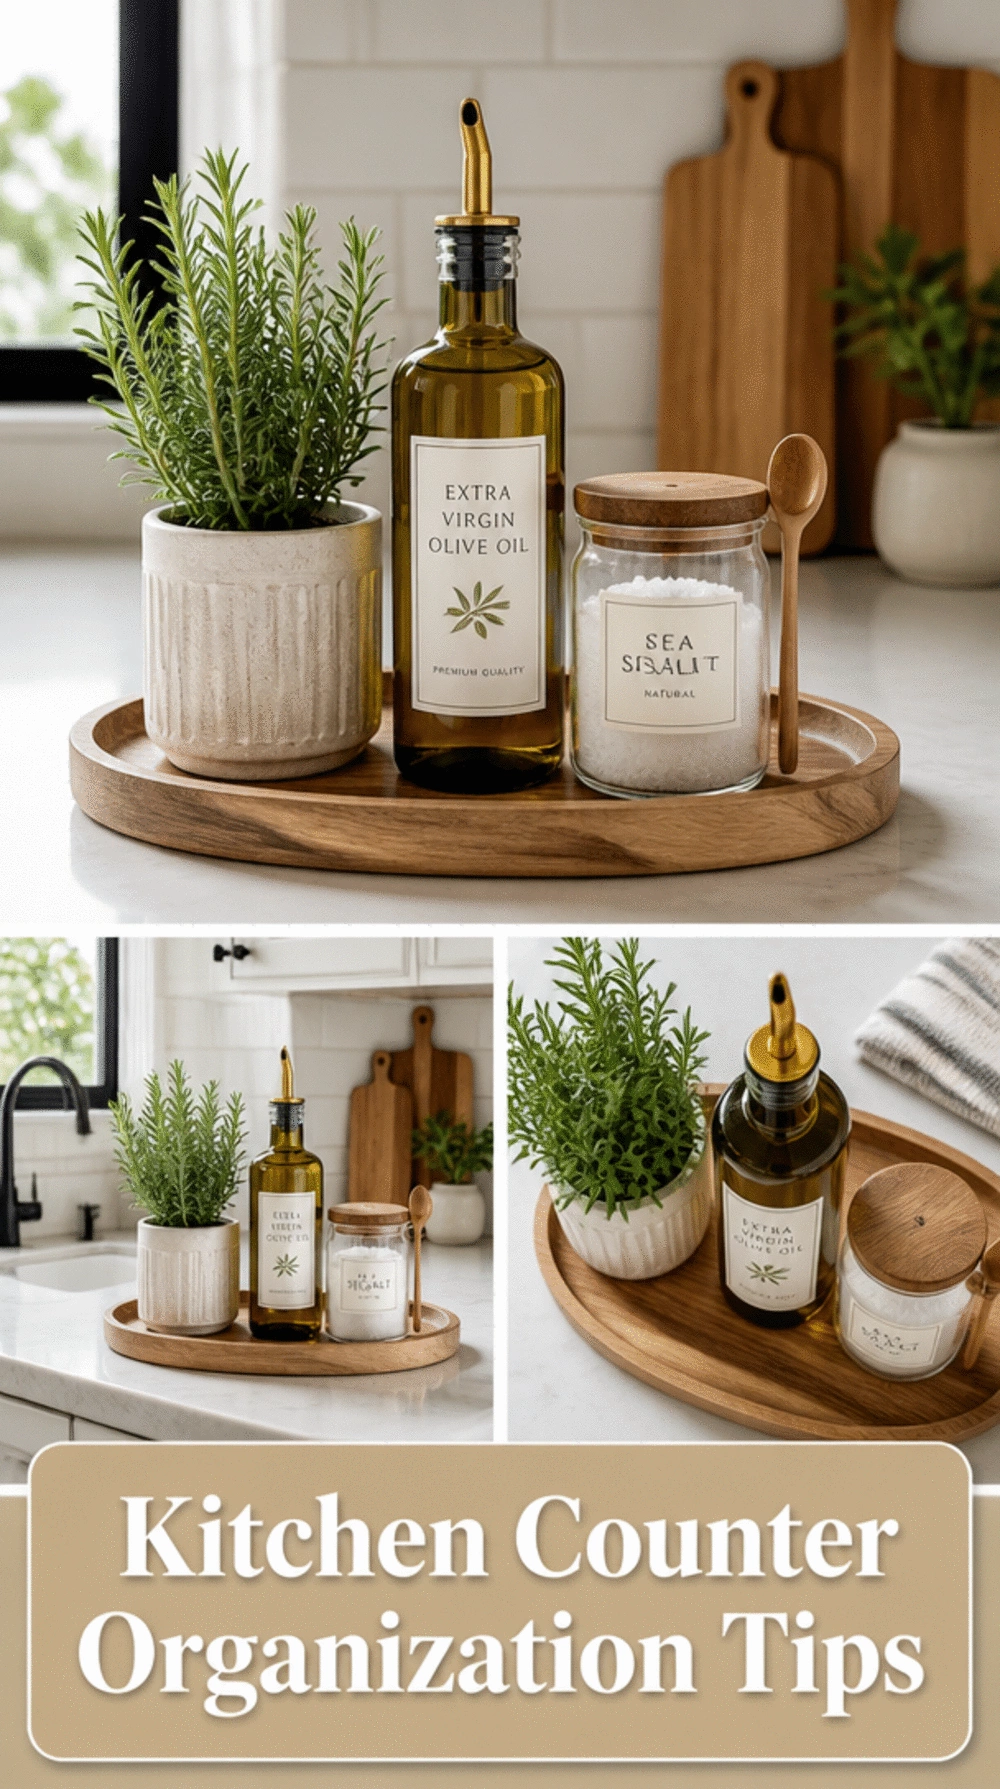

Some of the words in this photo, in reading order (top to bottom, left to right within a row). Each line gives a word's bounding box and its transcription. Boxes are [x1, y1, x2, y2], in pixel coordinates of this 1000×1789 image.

[446, 484, 511, 501] EXTRA
[442, 511, 515, 529] VIRGIN
[428, 537, 487, 555] OLIVE
[496, 537, 529, 555] OIL
[645, 633, 694, 651] SEA
[481, 666, 525, 677] QUALITY
